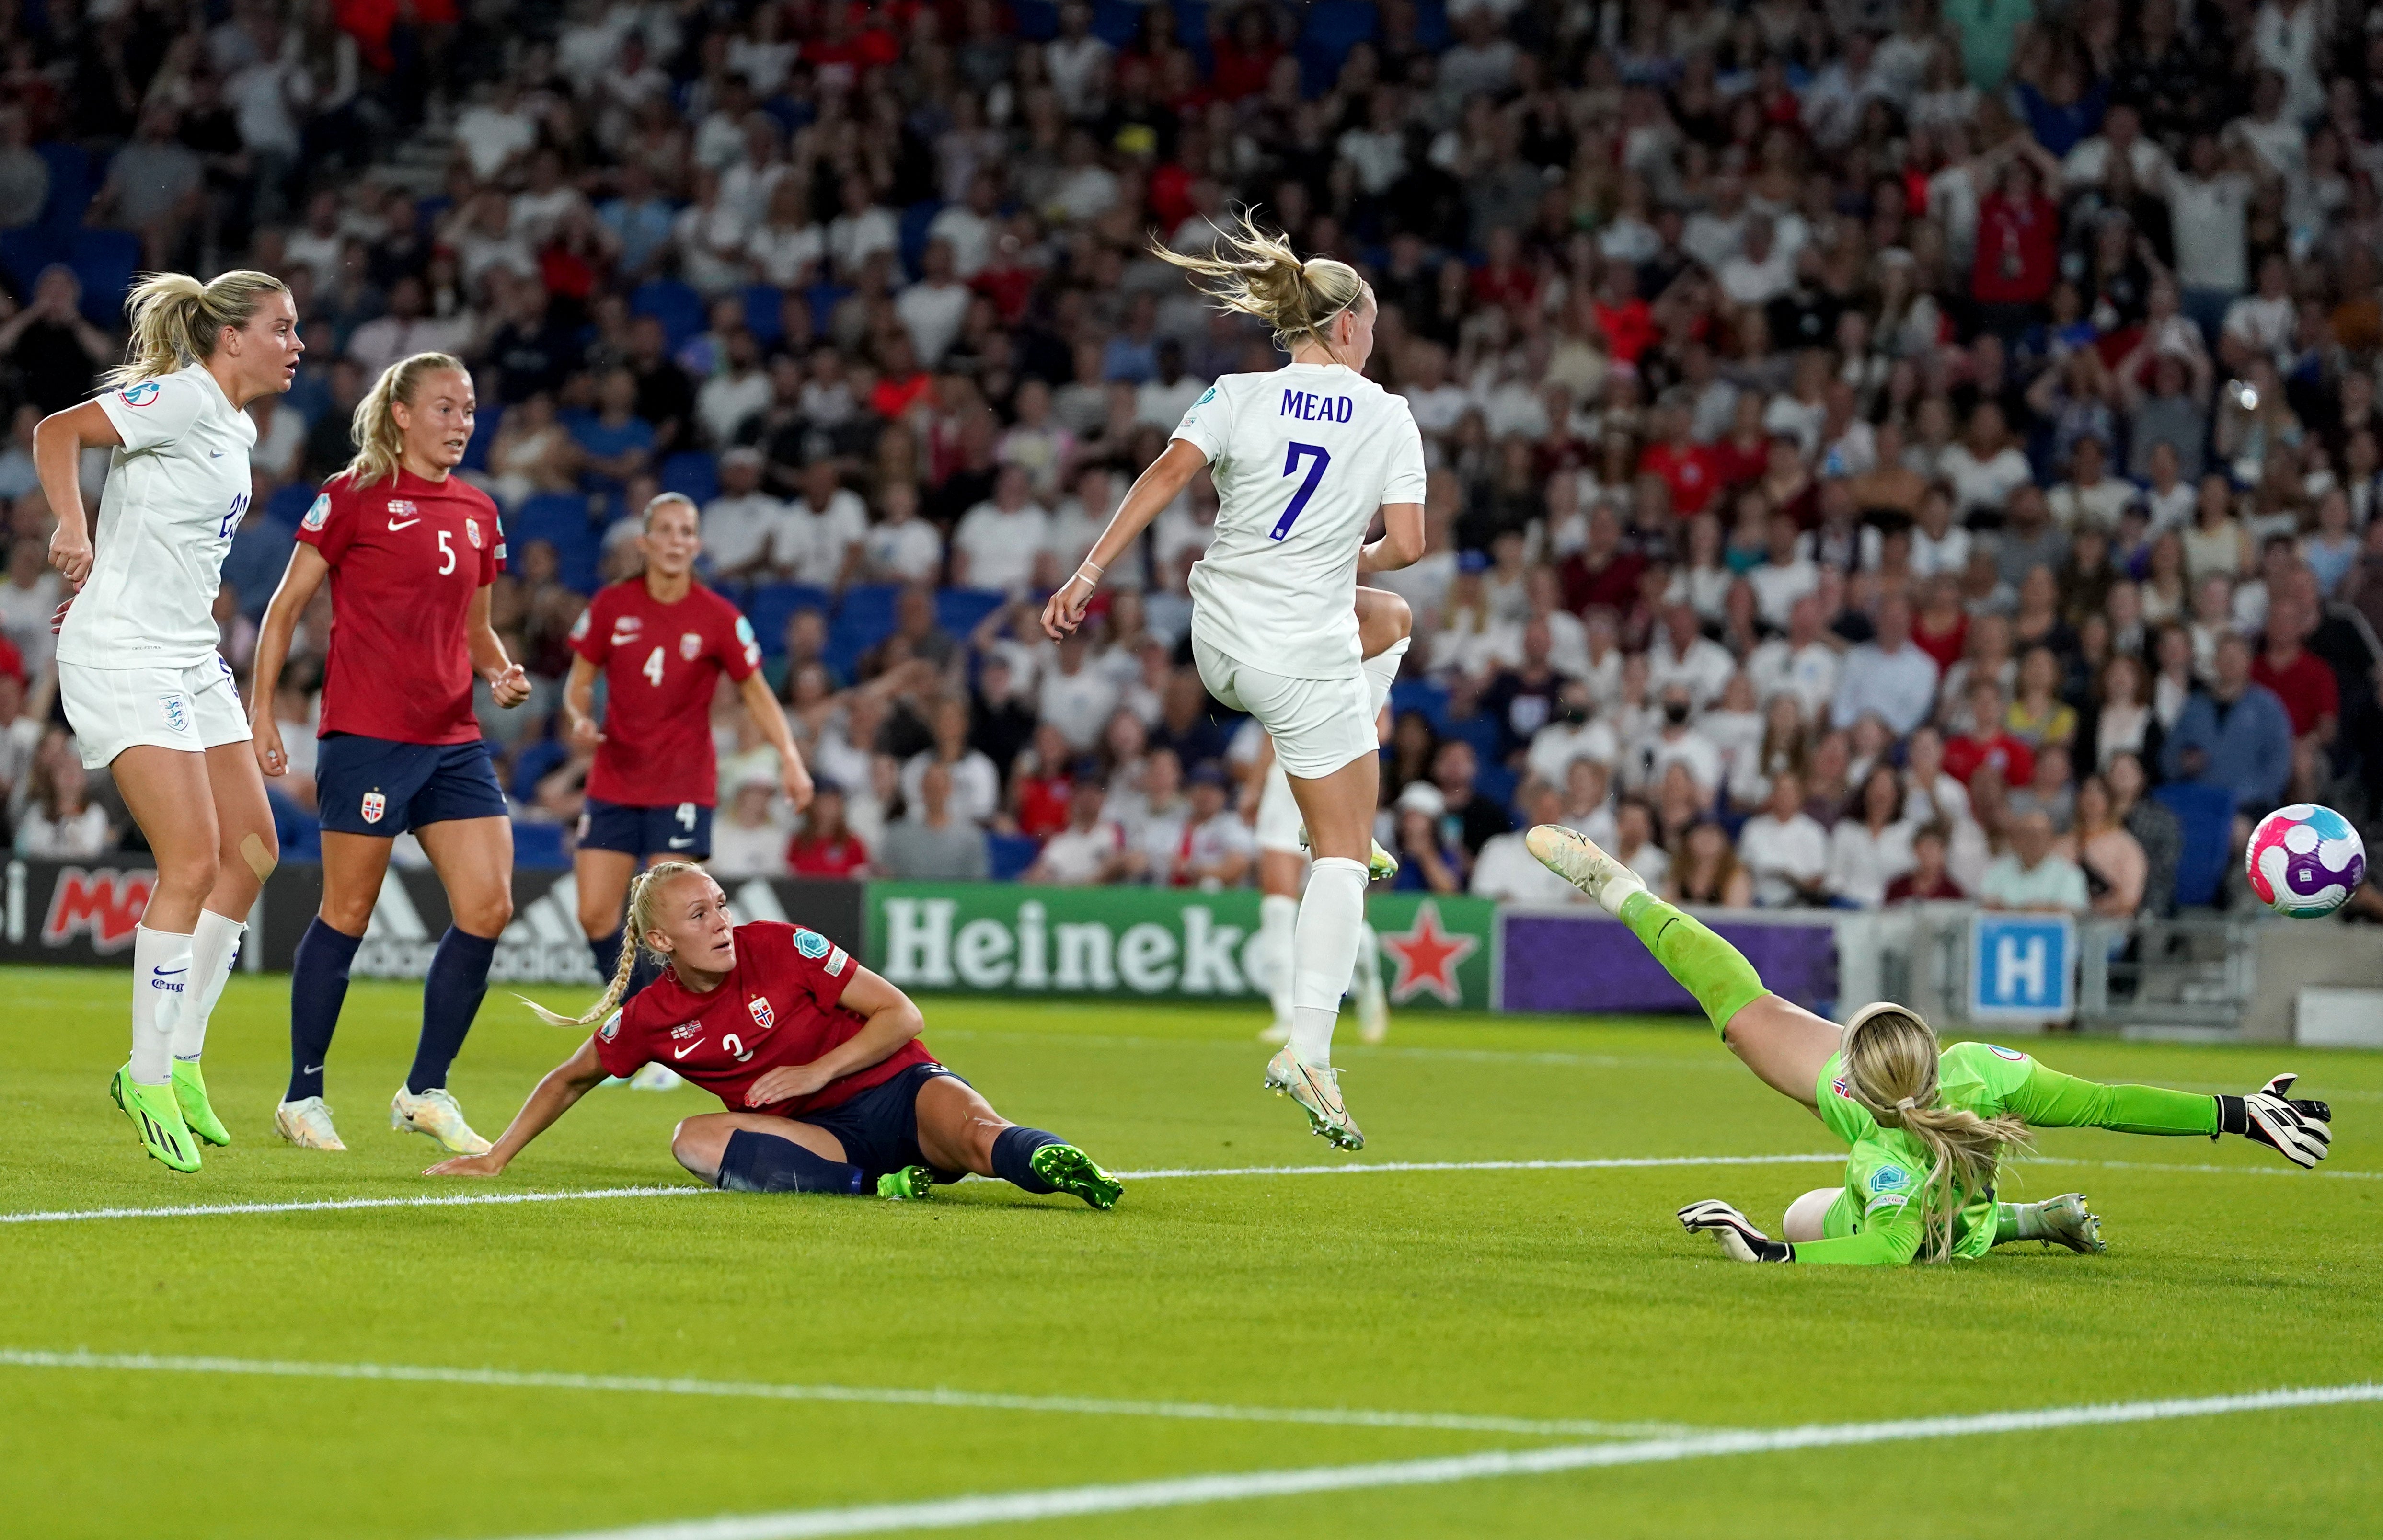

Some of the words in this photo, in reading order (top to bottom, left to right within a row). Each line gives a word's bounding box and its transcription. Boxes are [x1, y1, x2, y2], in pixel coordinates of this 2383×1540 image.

[1281, 389, 1353, 423] MEAD
[1269, 441, 1331, 541] 7
[437, 530, 456, 575] 5
[643, 646, 664, 687] 4
[675, 803, 697, 831] 4
[43, 868, 156, 951] MA
[1996, 935, 2047, 999] H
